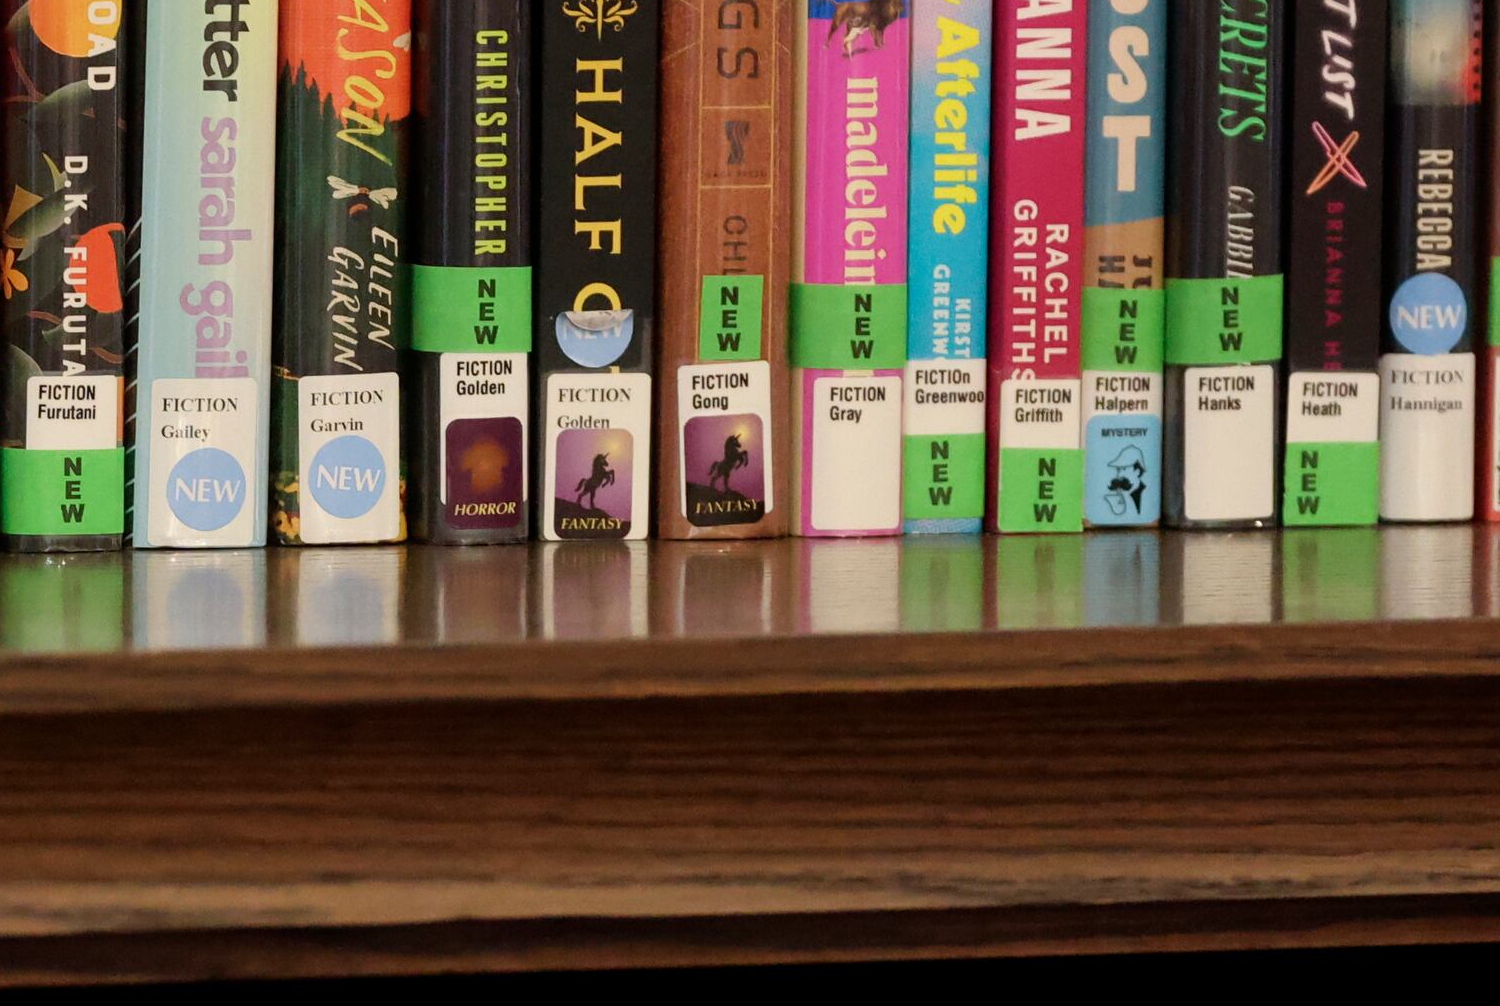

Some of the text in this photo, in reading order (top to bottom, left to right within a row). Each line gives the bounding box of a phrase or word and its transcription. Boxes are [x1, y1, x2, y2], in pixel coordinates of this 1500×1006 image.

[1322, 30, 1355, 120] LIST
[932, 16, 980, 236] Afterlife
[474, 29, 508, 256] CHRISTOPHER
[574, 57, 623, 255] HALF
[64, 155, 88, 187] D.
[197, 116, 252, 266] sarah
[64, 198, 88, 225] K.
[1416, 149, 1454, 270] REBECCA
[1325, 202, 1345, 327] BRIANNA
[367, 226, 398, 350] EILEEN
[1011, 199, 1038, 380] GRIFFITHS
[1044, 223, 1070, 364] RACHEL
[326, 245, 366, 371] GARVIN
[955, 298, 971, 358] KIRST
[456, 379, 505, 395] Golden
[830, 386, 886, 403] FICTION
[692, 393, 729, 410] Gong
[915, 388, 985, 405] Greenwoo
[1095, 396, 1148, 412] Halpern
[1199, 396, 1242, 411] Hanks
[1390, 396, 1463, 412] Hannigan
[38, 404, 97, 420] Furutani
[830, 406, 862, 423] Gray
[1015, 408, 1063, 423] Griffith
[1303, 400, 1341, 416] Heath
[310, 418, 364, 433] Garvin
[557, 415, 611, 430] Golden
[161, 424, 211, 442] Gailey
[1101, 428, 1147, 437] MYSTERY
[454, 501, 516, 517] HORROR
[695, 499, 759, 514] FANTASY
[561, 516, 622, 531] FANTASY
